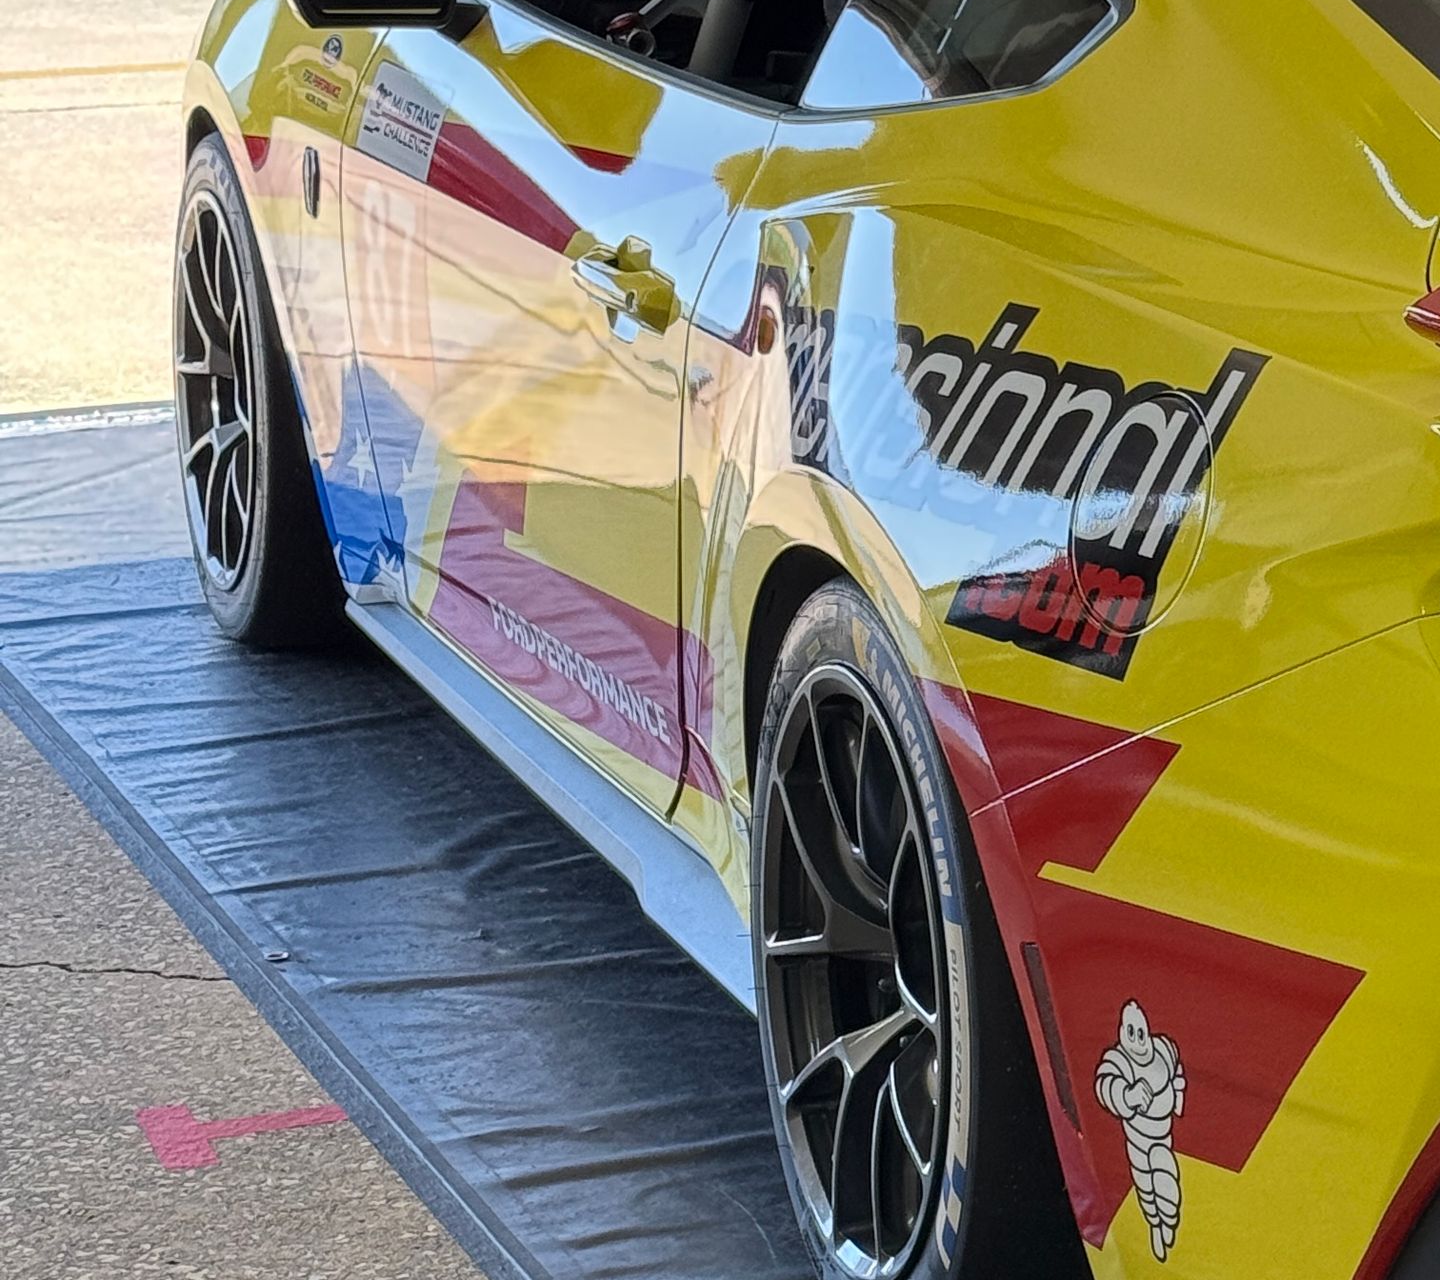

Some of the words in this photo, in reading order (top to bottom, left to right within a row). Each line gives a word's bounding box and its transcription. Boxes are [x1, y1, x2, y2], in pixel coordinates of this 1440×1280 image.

[881, 668, 953, 898] MICHELIN
[949, 948, 964, 1032] PILOT
[953, 1040, 965, 1133] SPORT
